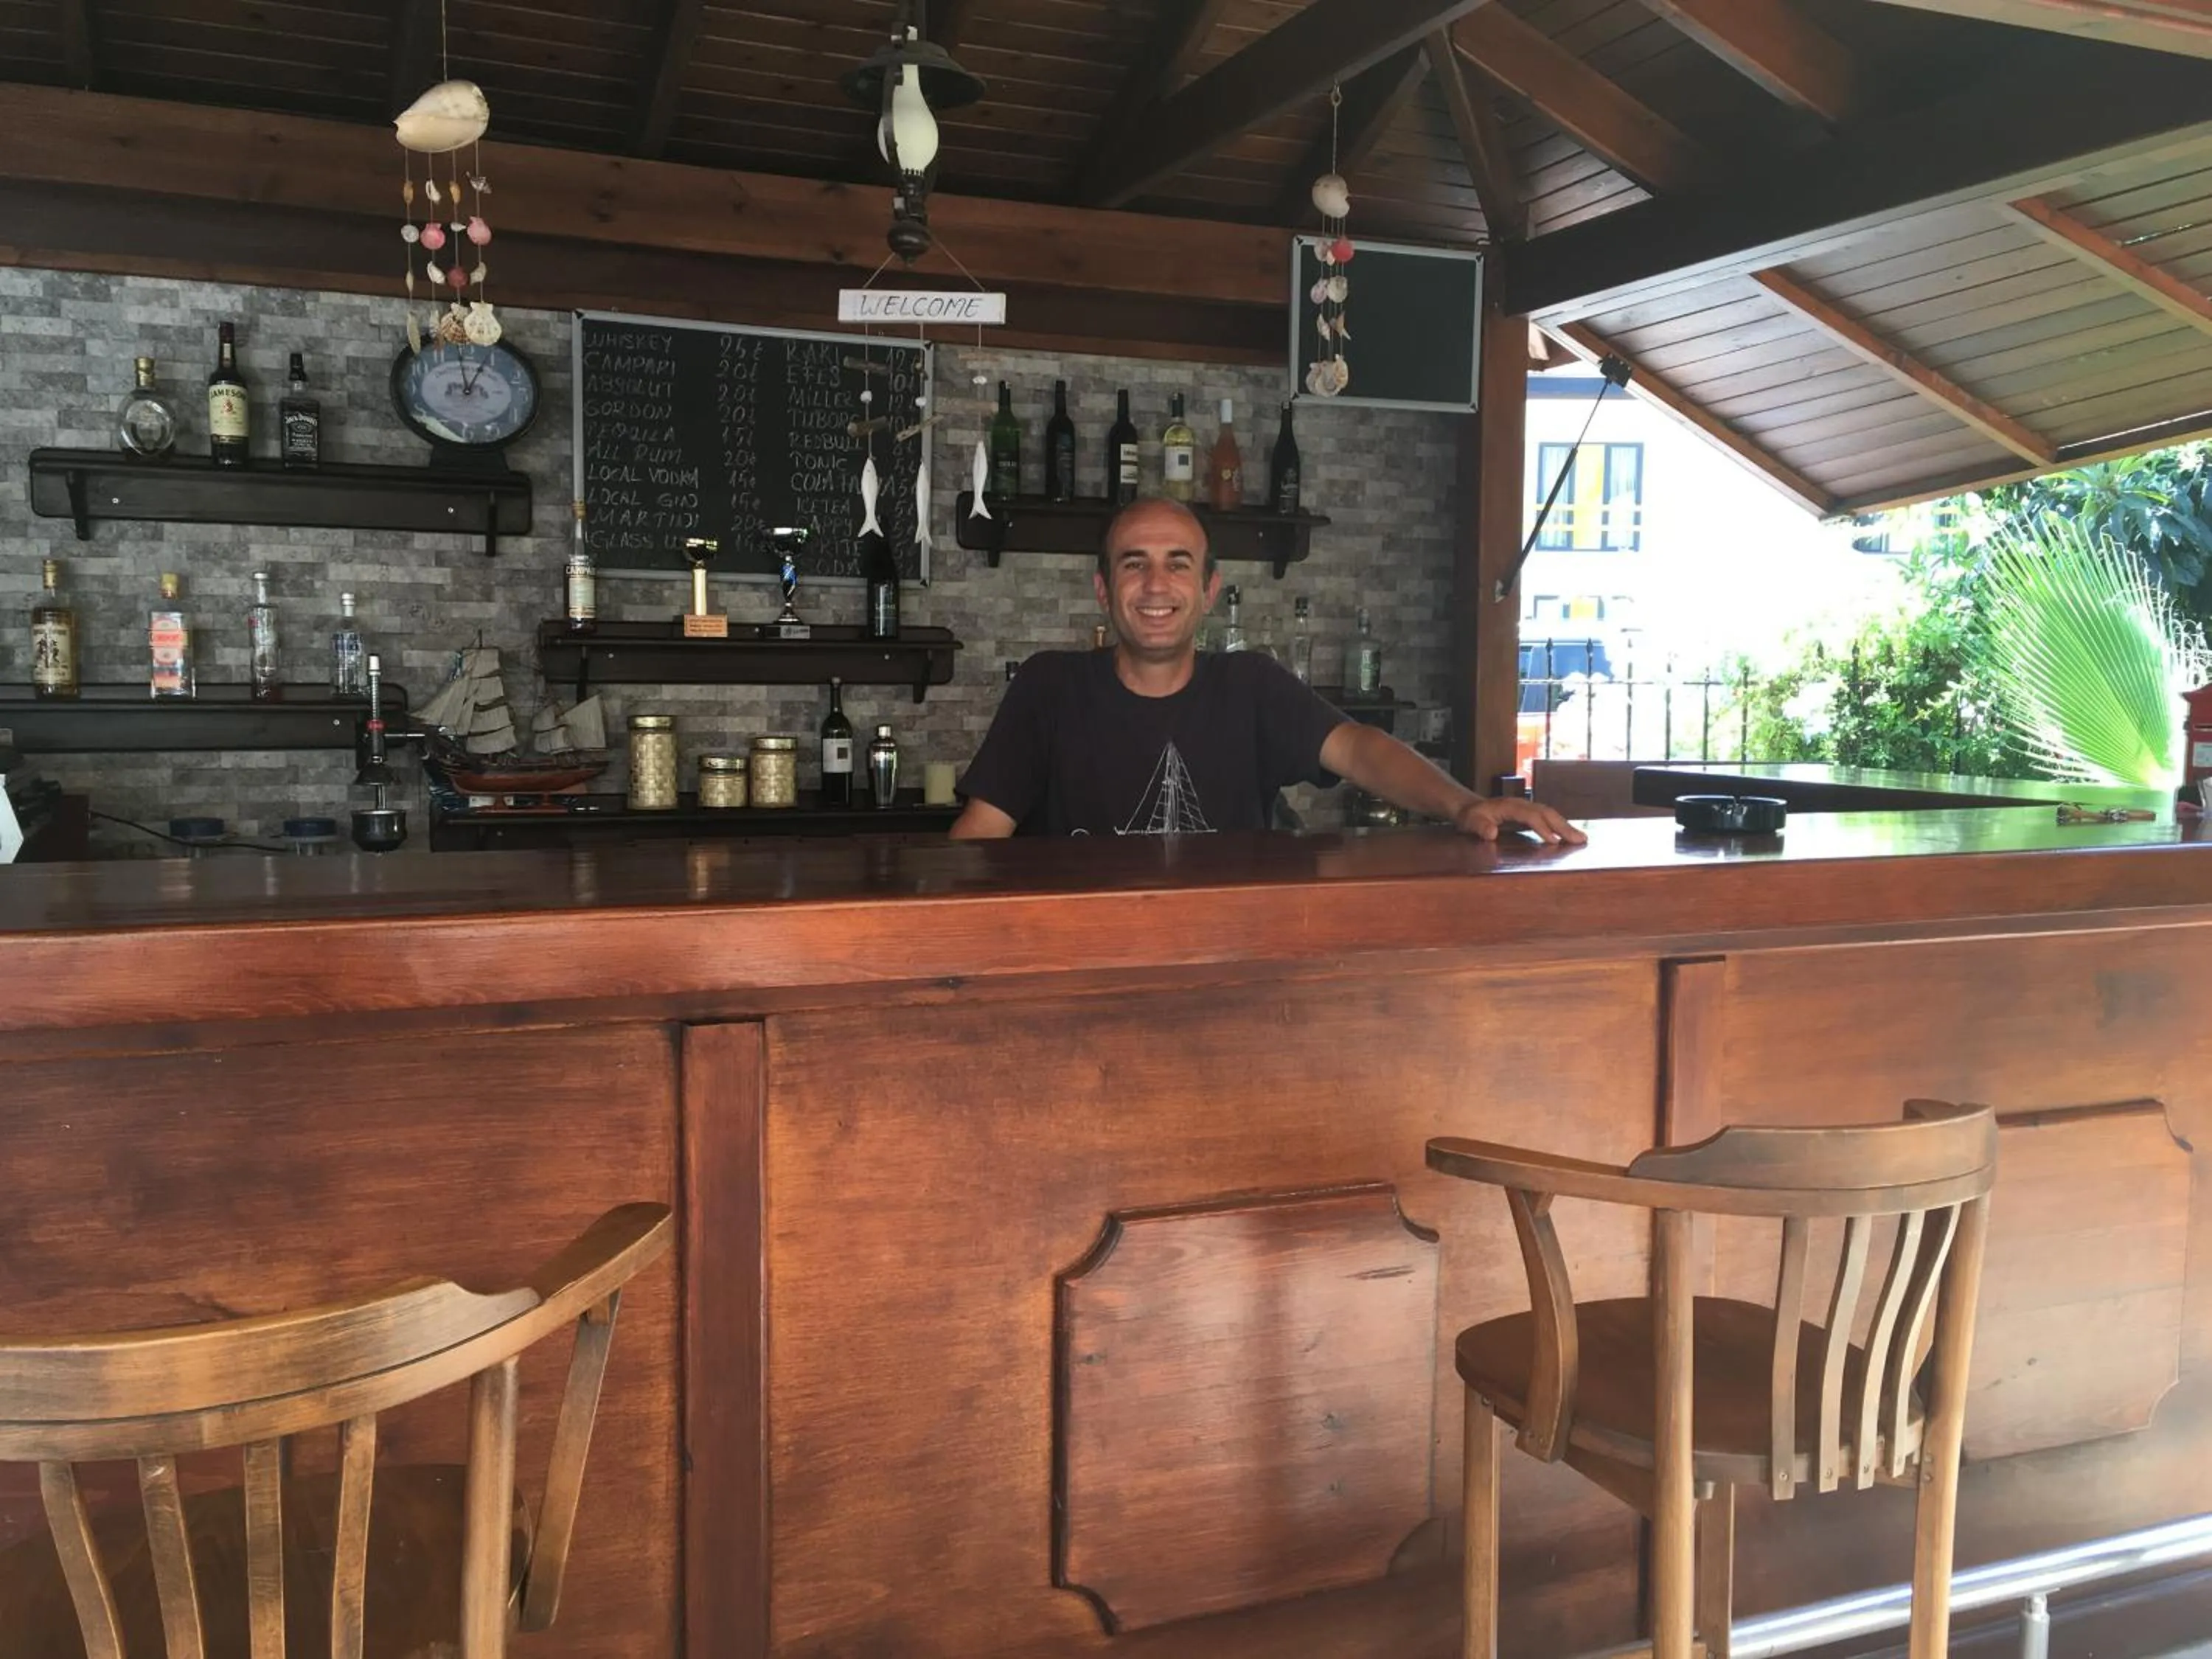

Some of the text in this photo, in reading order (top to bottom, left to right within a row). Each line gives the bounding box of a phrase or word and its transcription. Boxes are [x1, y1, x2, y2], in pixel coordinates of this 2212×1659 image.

[860, 295, 983, 318] WELCOME
[583, 332, 672, 354] WHISKEY
[785, 341, 839, 366] RAKI
[584, 351, 675, 376] CAMPARI
[585, 374, 672, 397] ABSOLUT
[787, 363, 840, 387] EFES
[211, 389, 246, 400] JAMESON
[584, 400, 672, 419] GORDON
[588, 440, 682, 464] ALL RUM
[789, 431, 863, 452] REDBULL
[790, 451, 847, 471] TONIC
[588, 463, 699, 490] LOCAL VODKA
[790, 470, 834, 492] COLA
[586, 487, 698, 508] LOCAL GIN
[589, 509, 700, 528] MARTINI
[591, 530, 654, 549] GLASS
